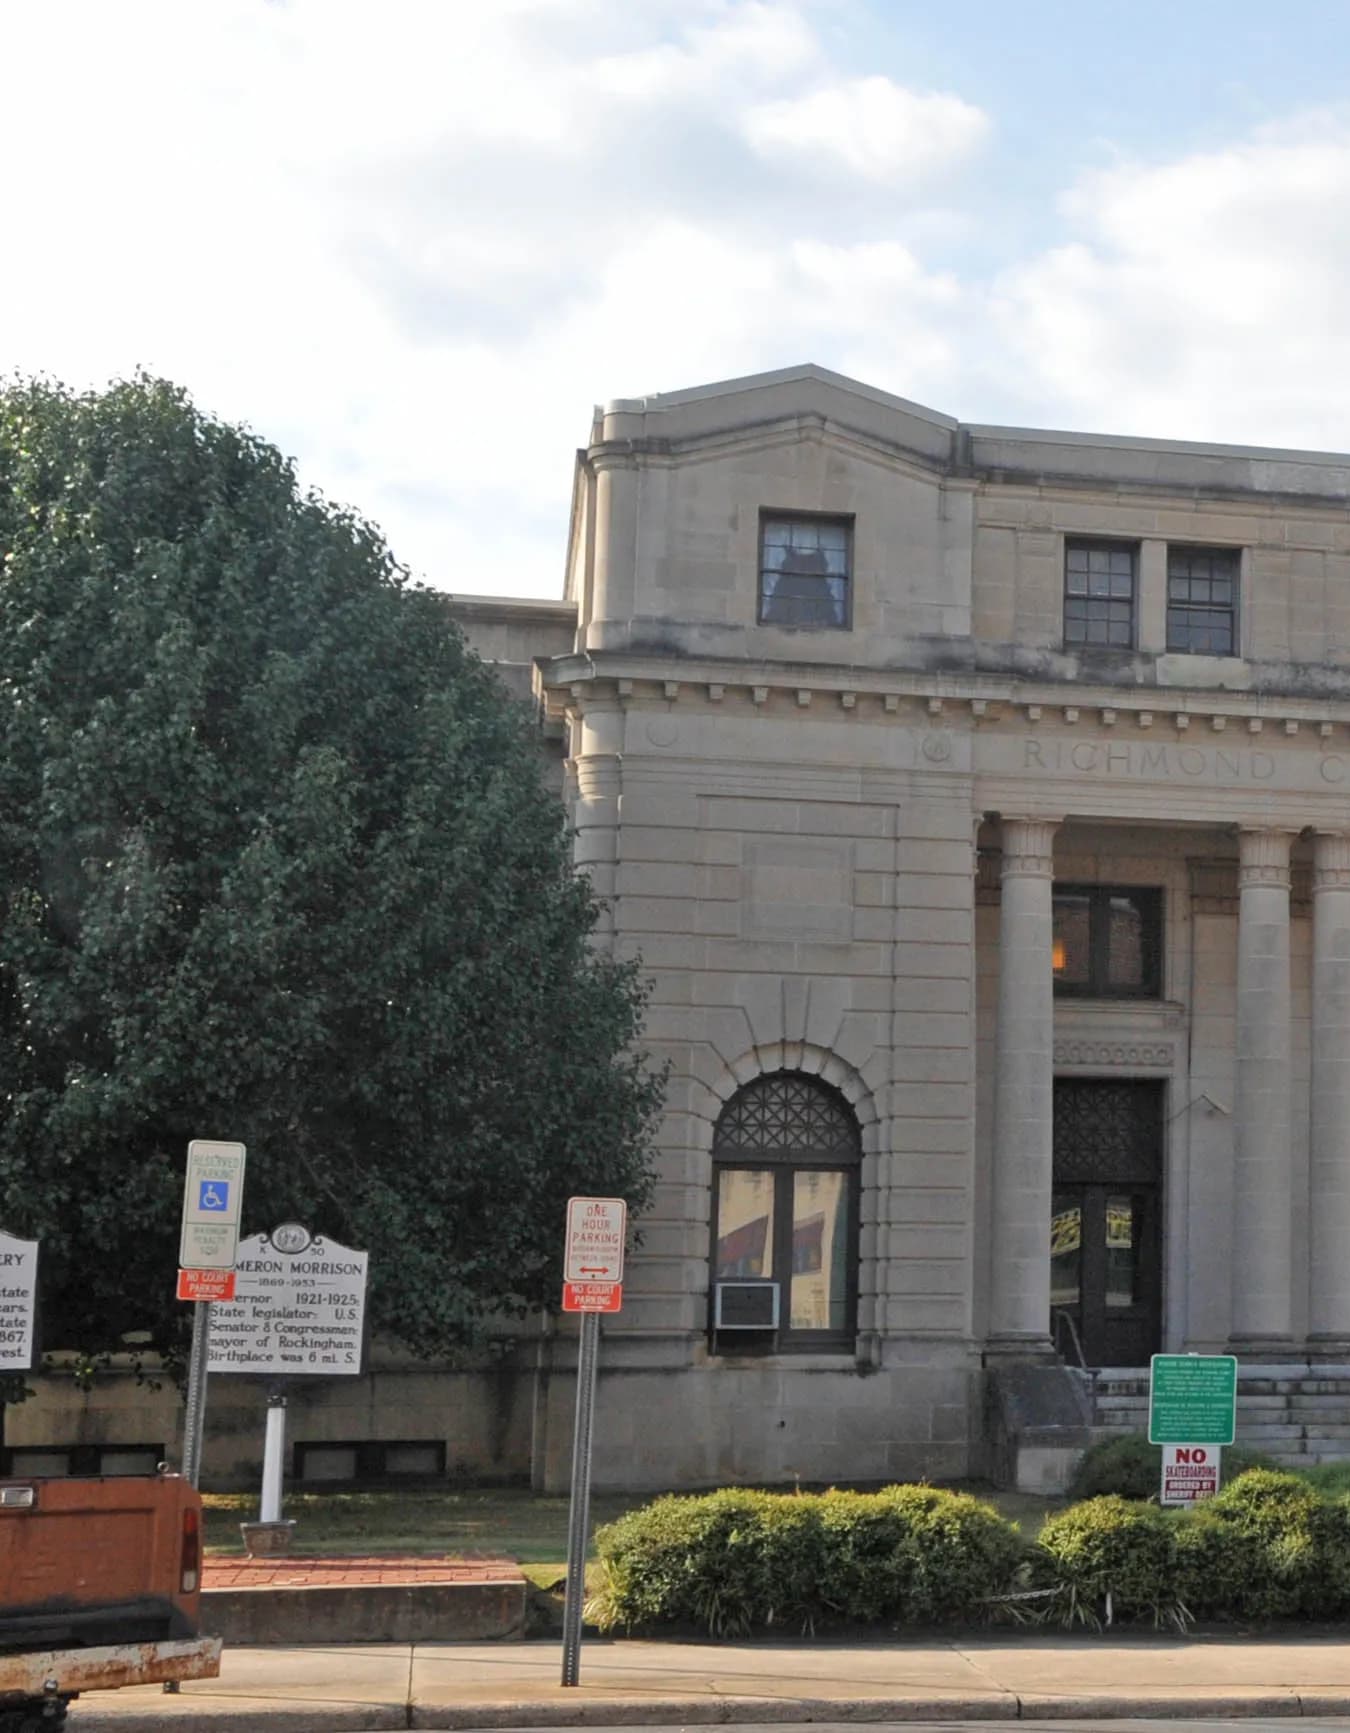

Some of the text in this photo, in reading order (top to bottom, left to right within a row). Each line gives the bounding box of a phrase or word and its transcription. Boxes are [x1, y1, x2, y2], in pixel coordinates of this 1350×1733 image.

[1023, 739, 1276, 780] RICHMOND
[193, 1155, 239, 1168] RESERVED
[196, 1168, 234, 1180] PARKING
[587, 1206, 608, 1217] ONE
[582, 1220, 611, 1231] HOUR
[573, 1232, 619, 1244] PARKING
[234, 1261, 362, 1275] MERON MORRISON
[186, 1272, 228, 1283] NO COURT
[0, 1287, 29, 1298] tate
[189, 1283, 225, 1294] PARKING
[571, 1285, 613, 1295] NO COURT
[575, 1295, 610, 1305] PARKING
[209, 1306, 246, 1318] State
[335, 1309, 359, 1320] U.S.
[0, 1318, 27, 1328] tate
[209, 1320, 258, 1333] Senator
[256, 1336, 270, 1347] of
[279, 1336, 357, 1350] Rockingham.
[208, 1351, 274, 1364] Birthplace
[281, 1354, 303, 1363] was
[309, 1352, 317, 1362] 6
[344, 1352, 356, 1364] S.
[1175, 1448, 1207, 1464] NO
[1166, 1465, 1217, 1478] SKATEBOARDING
[1202, 1481, 1212, 1489] BY
